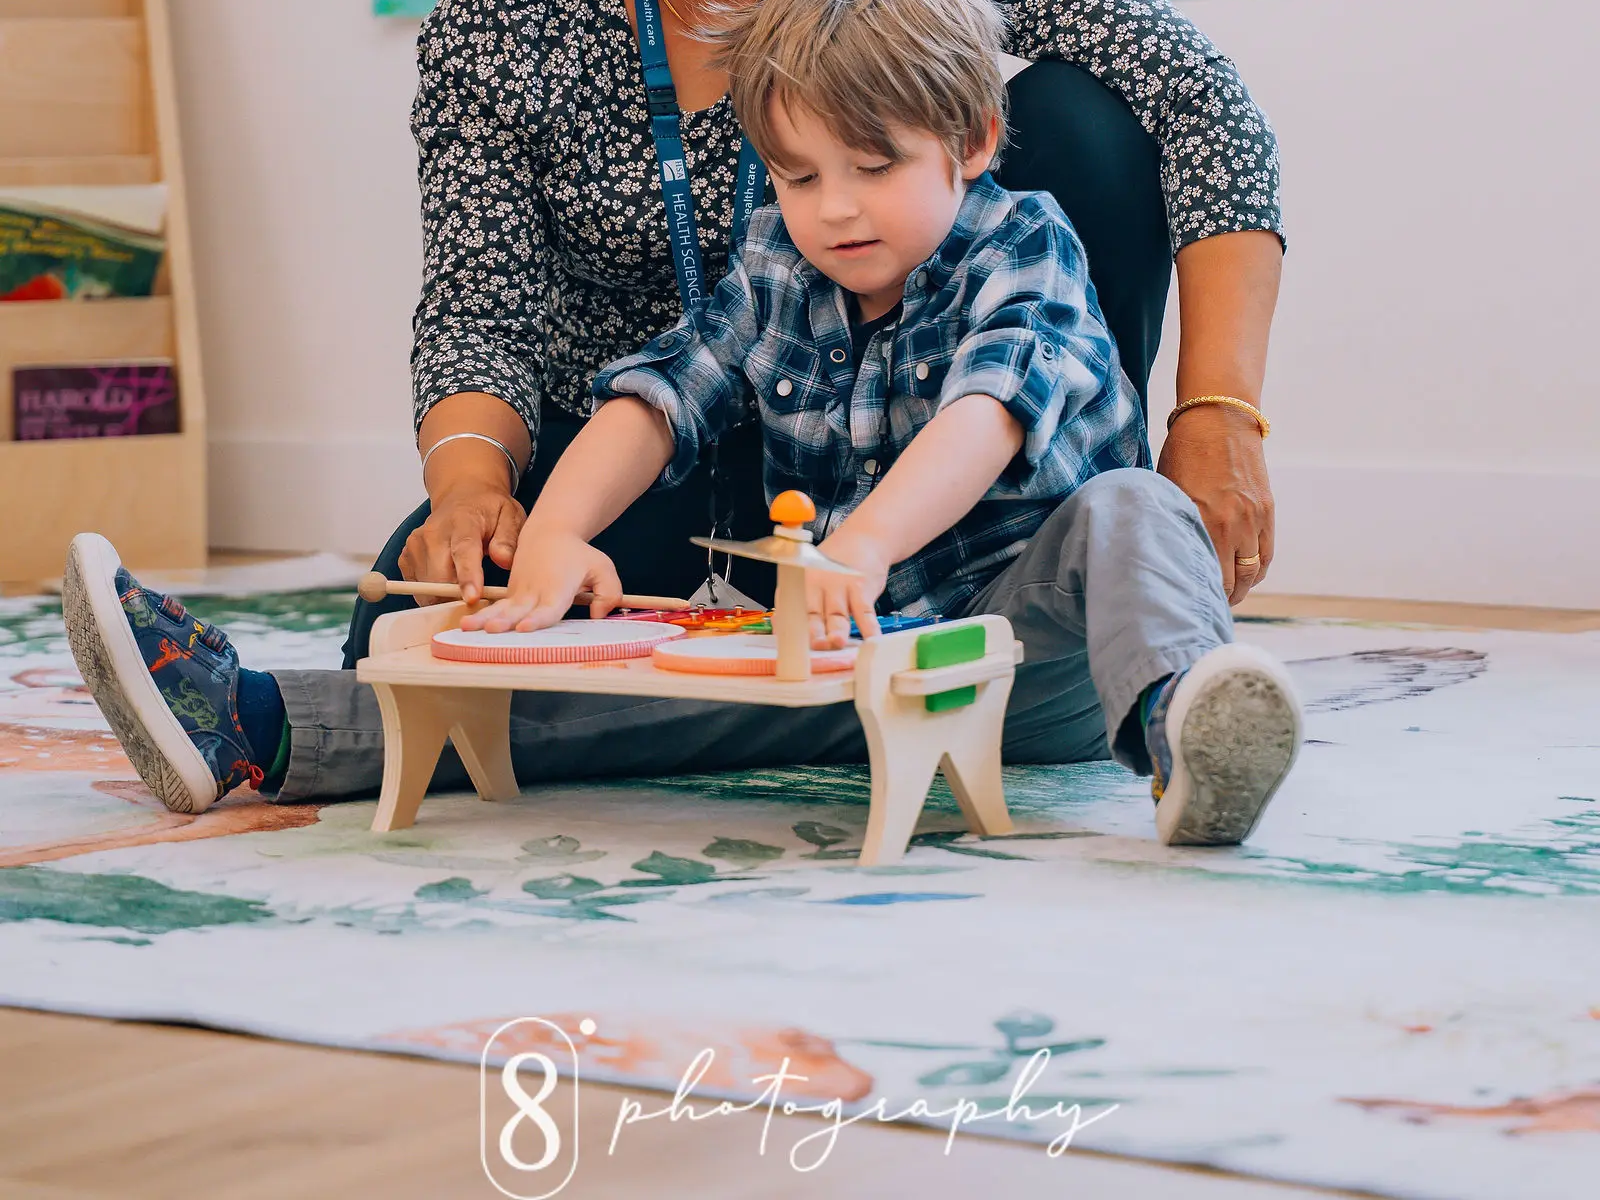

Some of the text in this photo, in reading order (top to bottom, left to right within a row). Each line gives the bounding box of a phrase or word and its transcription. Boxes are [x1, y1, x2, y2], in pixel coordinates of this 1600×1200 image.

[644, 23, 655, 46] care
[674, 159, 684, 179] HSA
[747, 163, 757, 185] care
[672, 193, 692, 246] HEALTH
